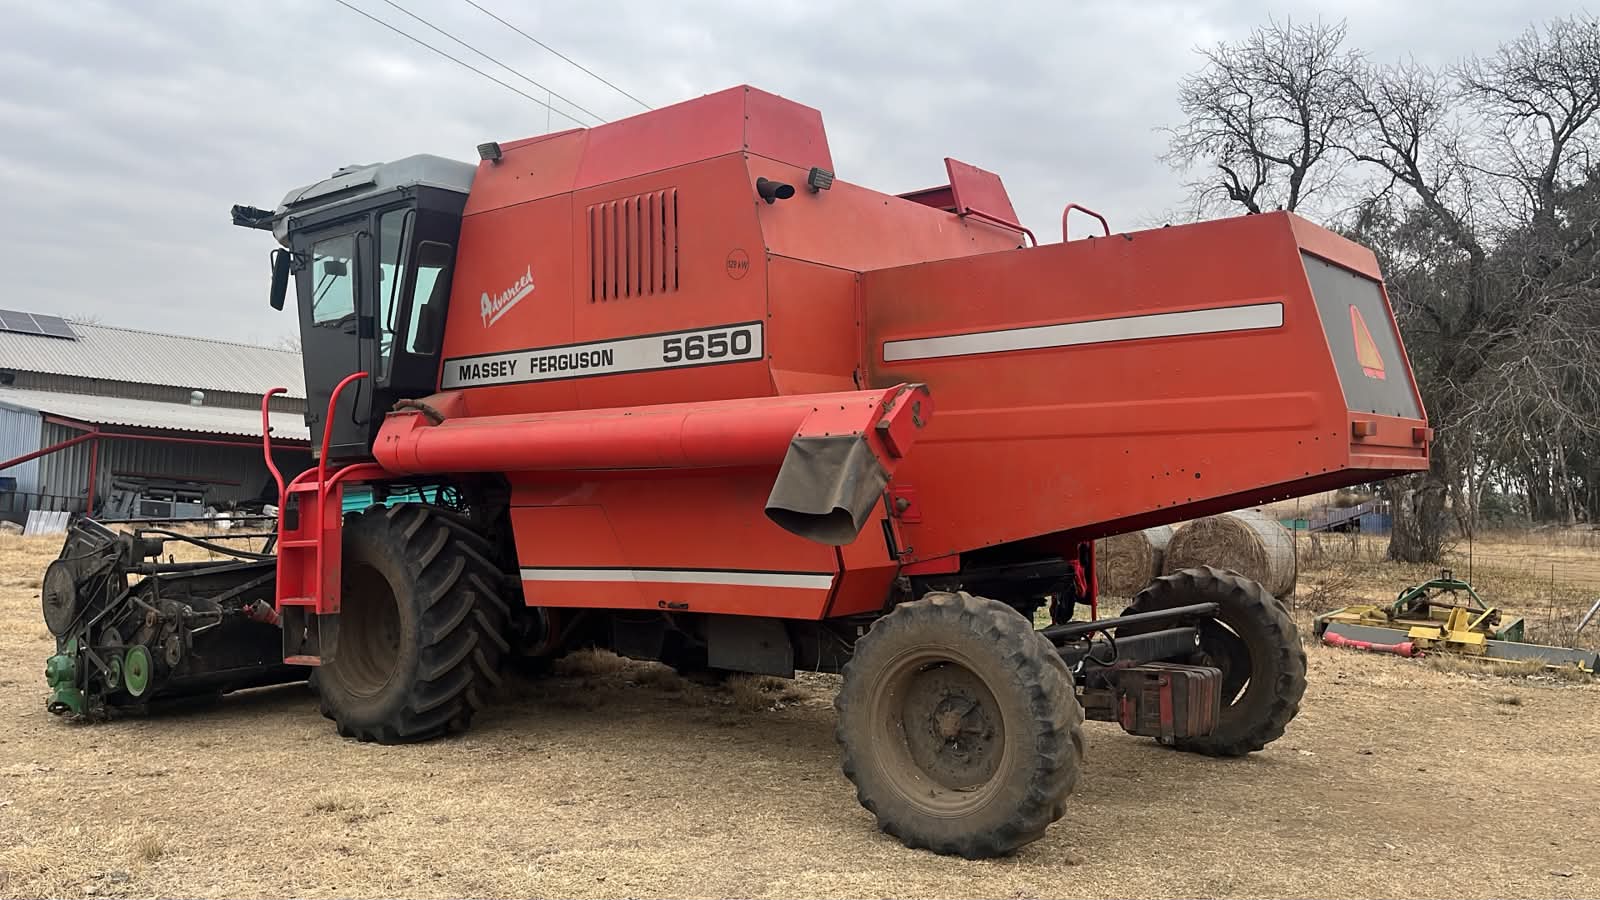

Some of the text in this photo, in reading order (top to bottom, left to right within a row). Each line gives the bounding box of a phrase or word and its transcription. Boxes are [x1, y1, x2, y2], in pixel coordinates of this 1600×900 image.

[480, 264, 533, 328] Advanced
[459, 329, 752, 381] MASSEY FERGUSON 5650
